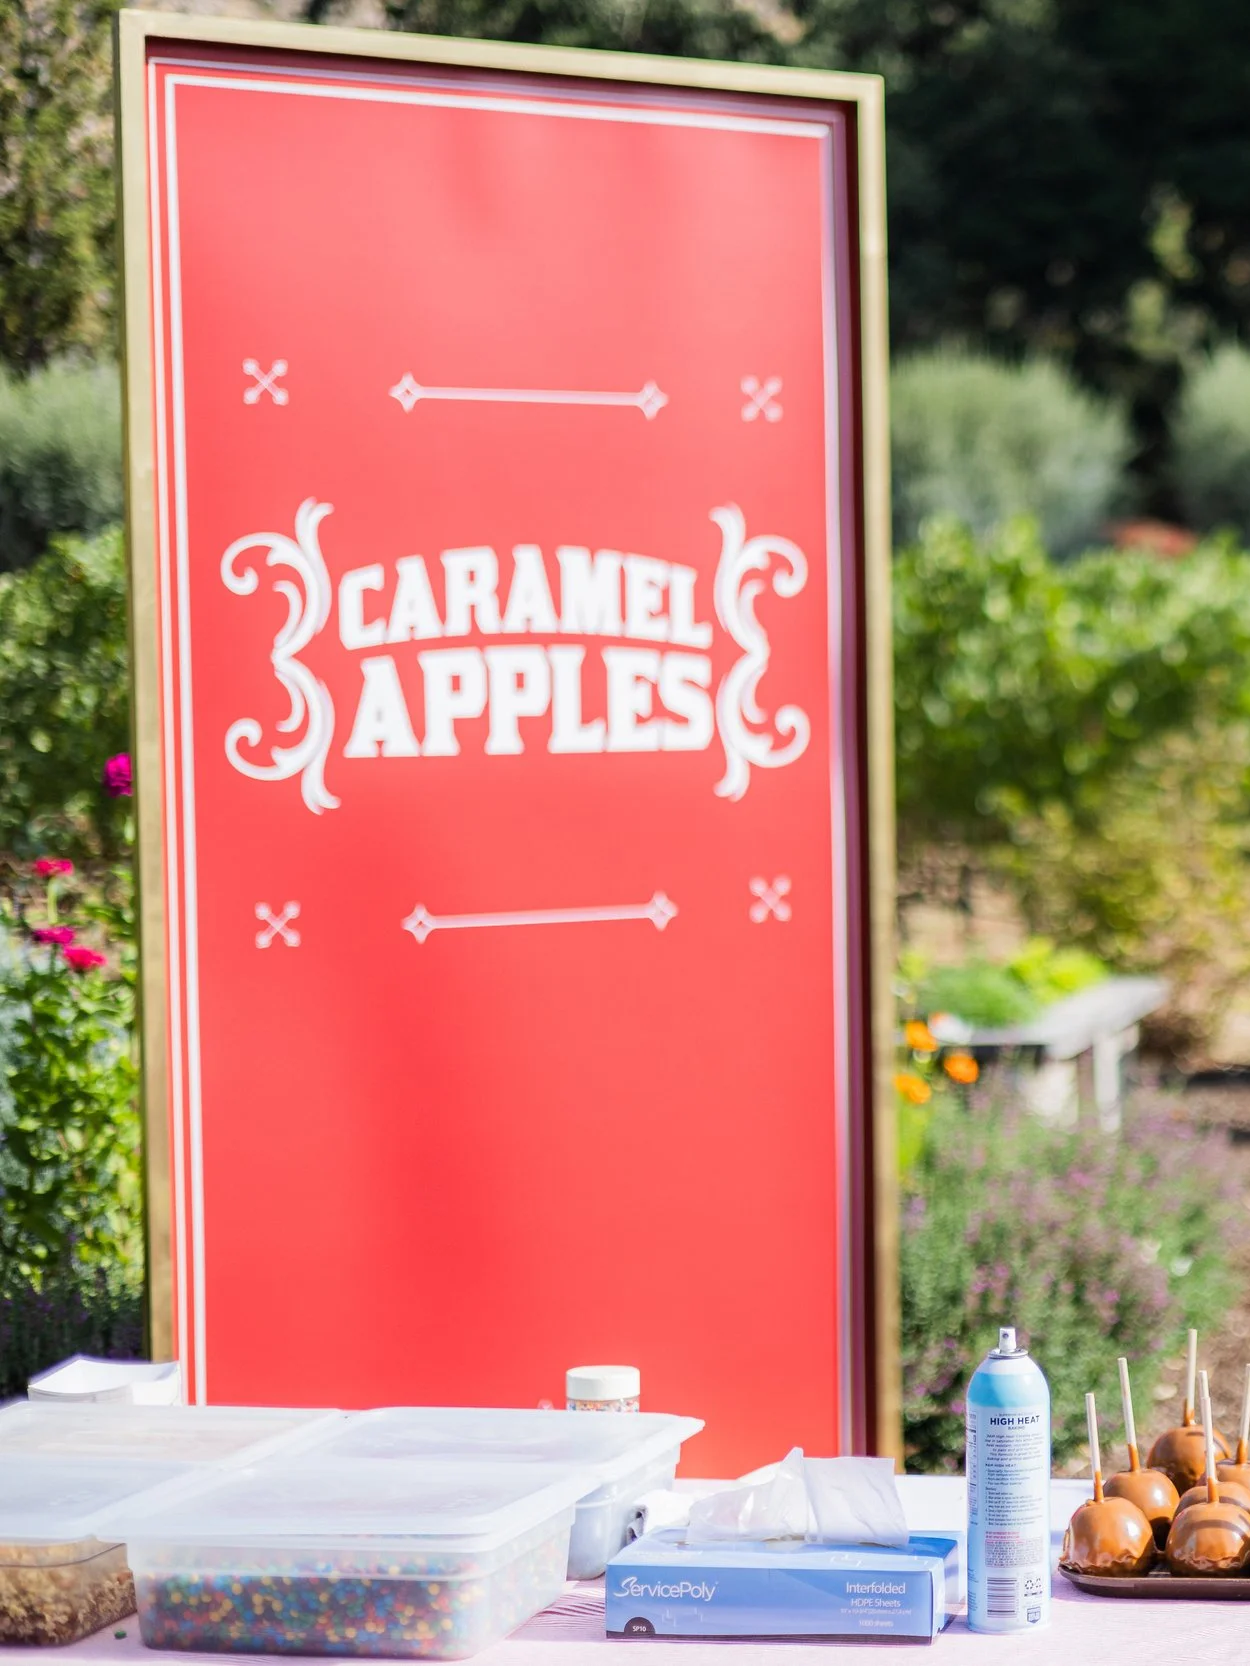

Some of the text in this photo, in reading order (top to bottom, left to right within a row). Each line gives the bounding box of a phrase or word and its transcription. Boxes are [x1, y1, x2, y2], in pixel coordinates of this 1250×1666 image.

[338, 544, 713, 651] CARAMEL
[343, 644, 715, 758] APPLES
[990, 1415, 1040, 1426] HIGH HEAT
[614, 1576, 716, 1601] ServicePoly
[846, 1582, 906, 1594] Interfolded
[851, 1598, 902, 1608] HDPE Sheets
